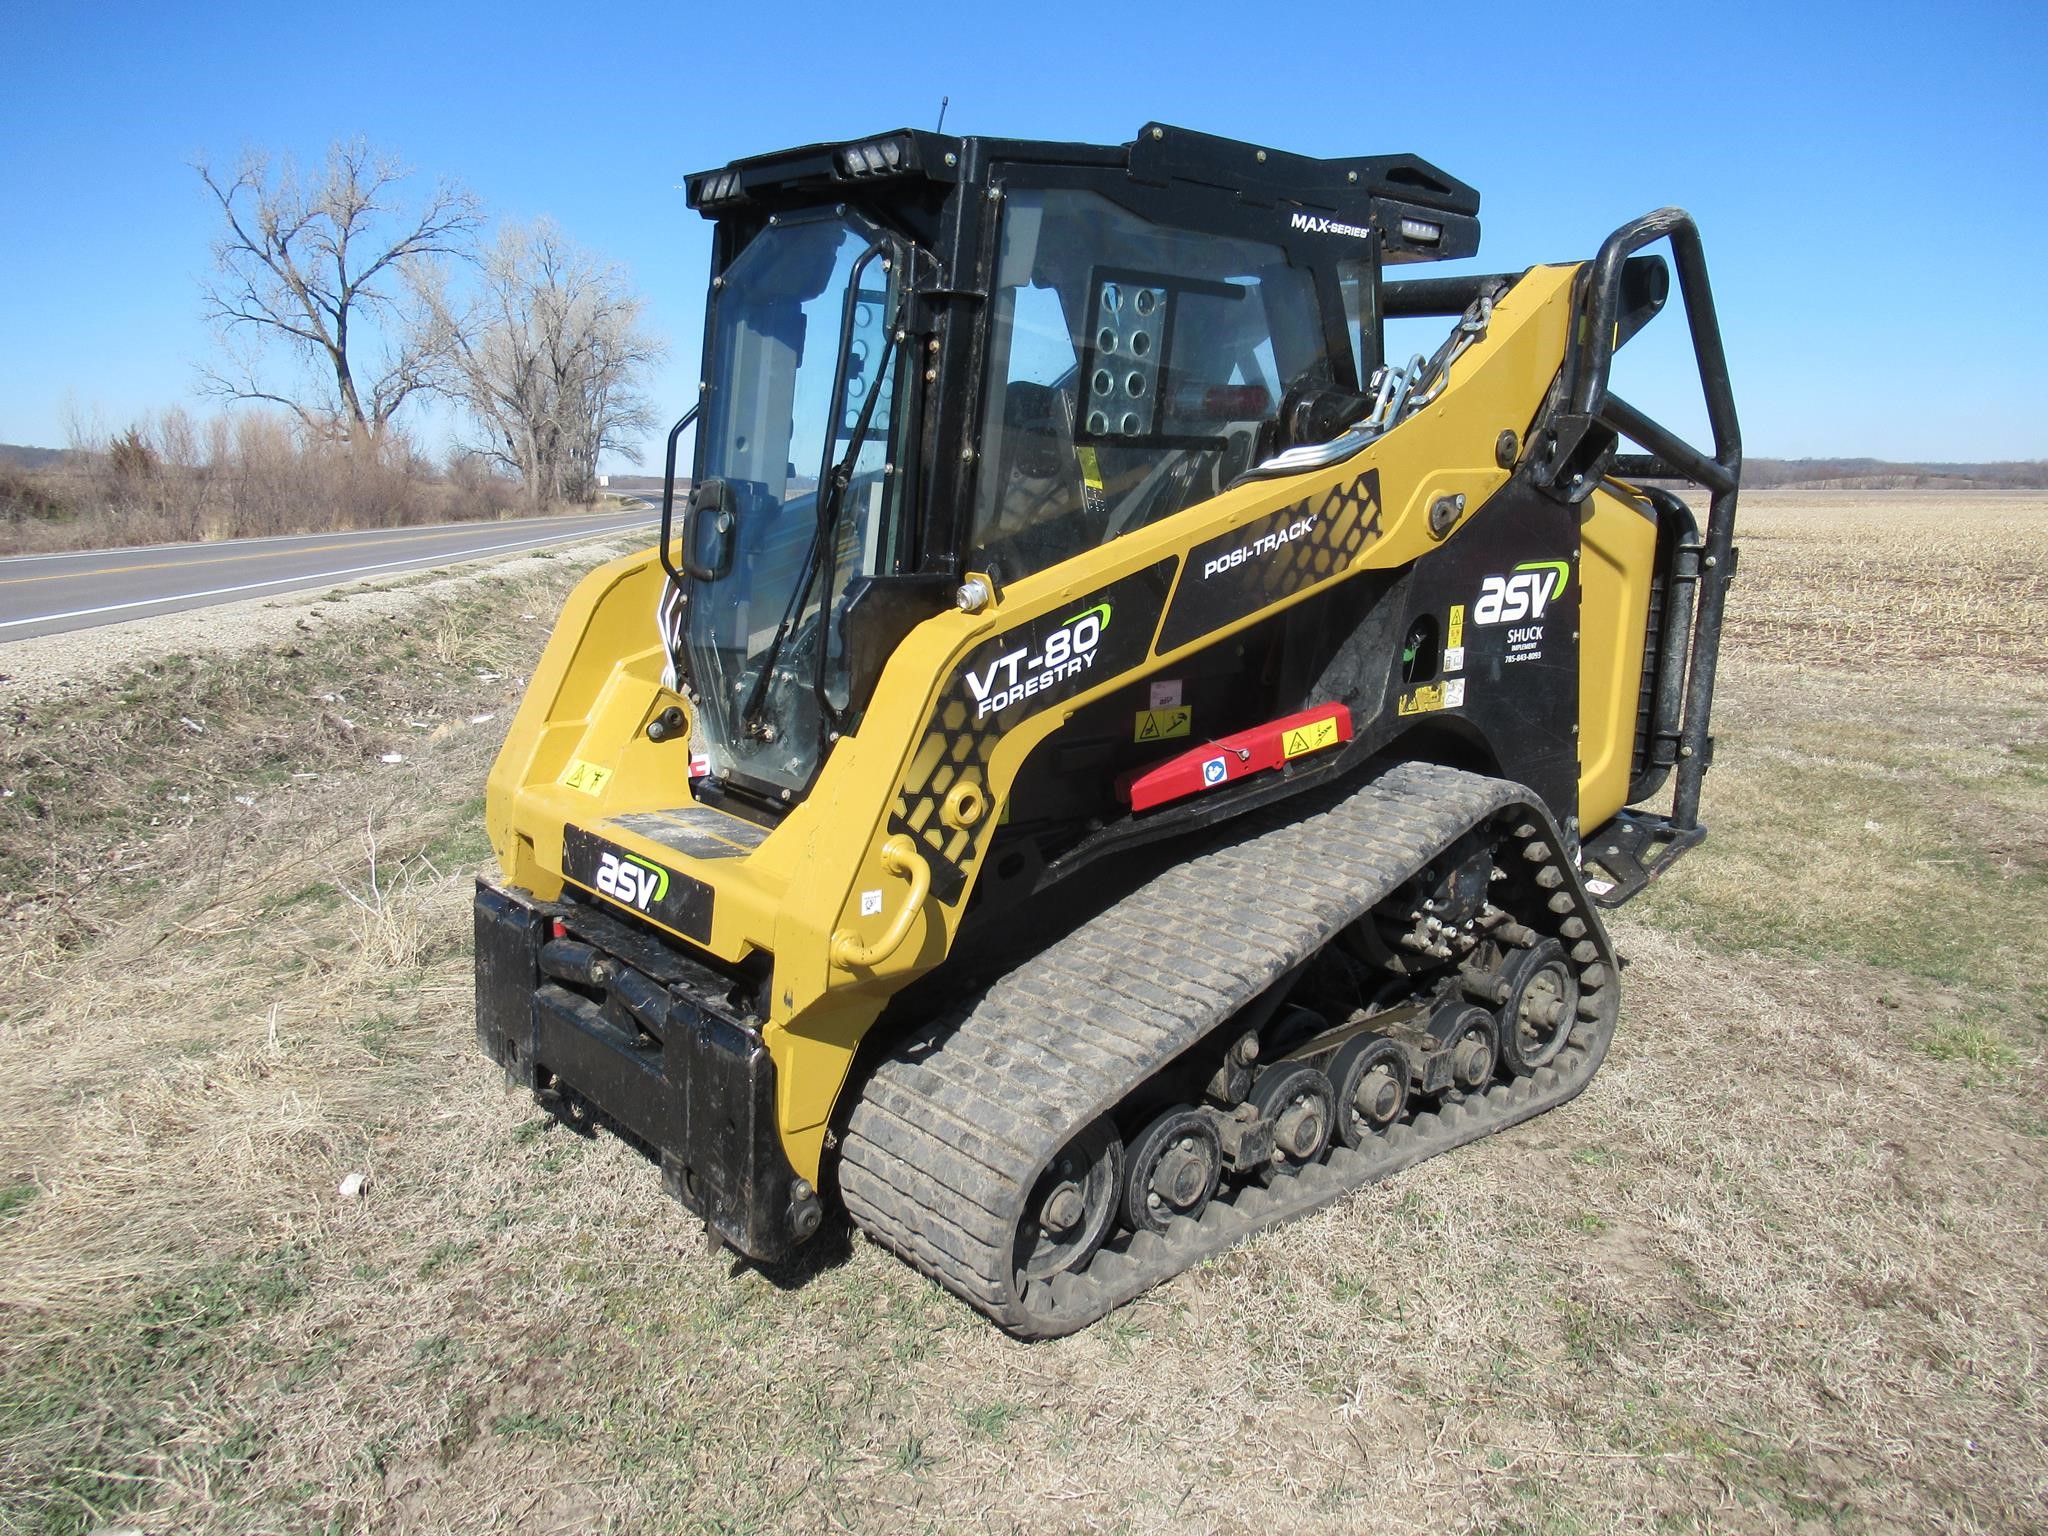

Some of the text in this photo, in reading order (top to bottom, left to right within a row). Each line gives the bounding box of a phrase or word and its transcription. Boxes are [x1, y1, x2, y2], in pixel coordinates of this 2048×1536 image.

[1291, 213, 1368, 239] MAX-SERIES
[965, 616, 1101, 702] VT-80
[1506, 626, 1544, 644] SHUCK
[978, 648, 1098, 720] FORESTRY
